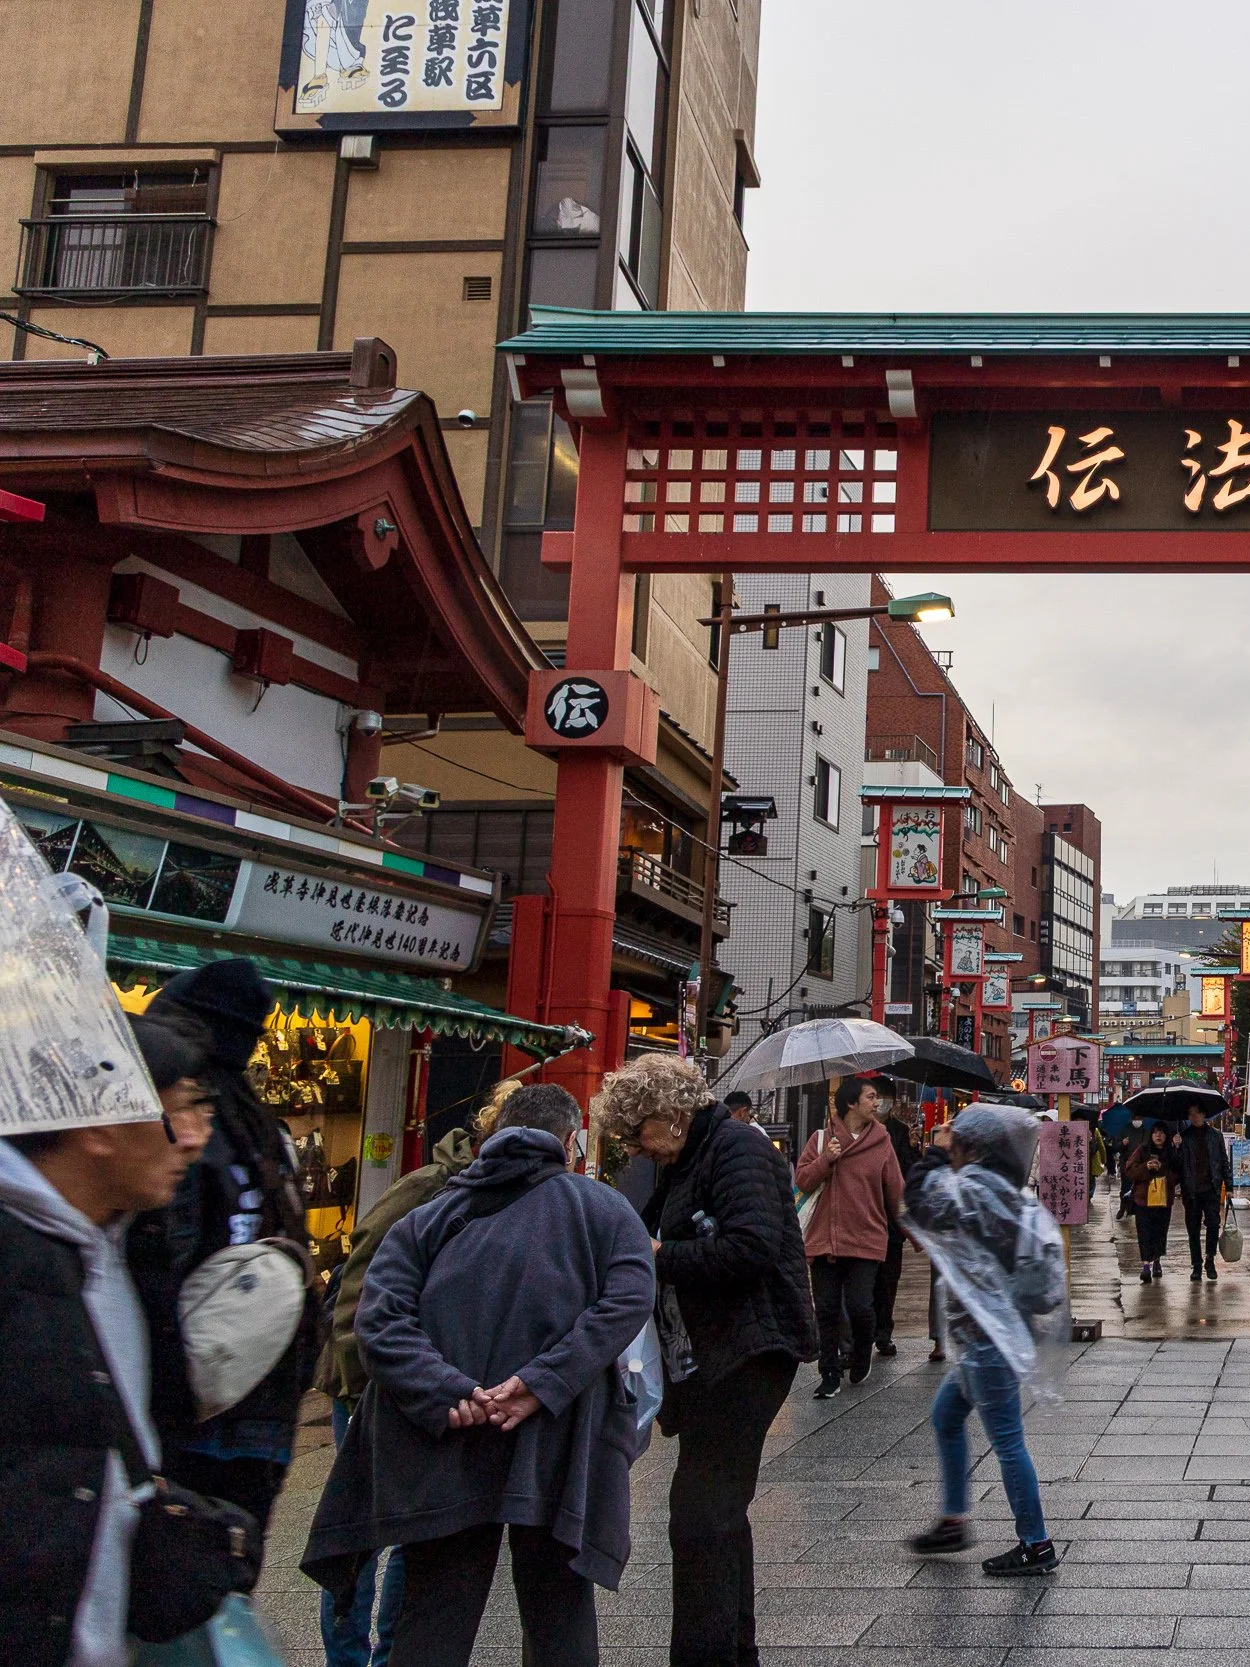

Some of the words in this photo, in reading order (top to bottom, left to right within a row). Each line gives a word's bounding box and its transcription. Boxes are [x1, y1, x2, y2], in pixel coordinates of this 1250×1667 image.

[377, 15, 416, 108] に至る
[465, 0, 503, 101] 草六区
[1035, 1064, 1047, 1090] 通行止
[1065, 1045, 1092, 1089] 下馬
